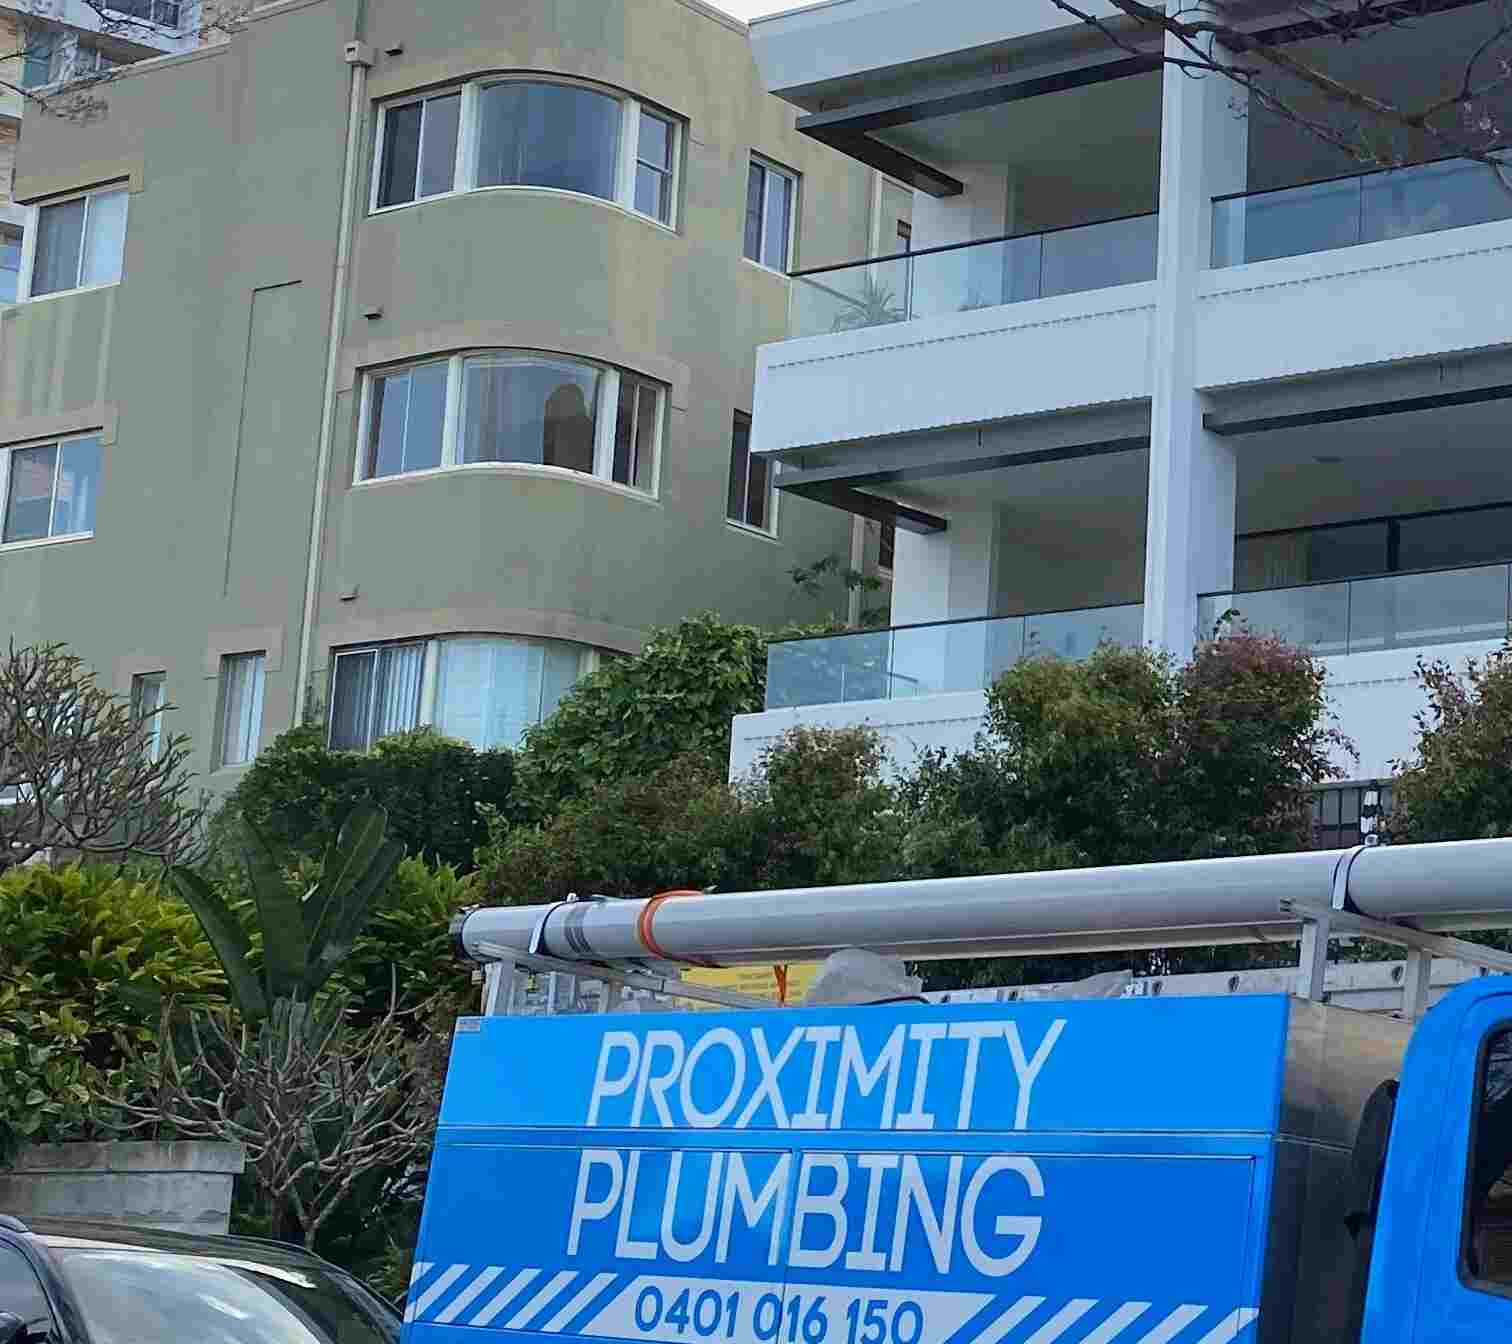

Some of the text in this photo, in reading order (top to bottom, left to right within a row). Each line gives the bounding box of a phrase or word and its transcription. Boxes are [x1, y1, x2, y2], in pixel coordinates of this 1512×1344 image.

[586, 1019, 1067, 1130] PROXIMITY
[567, 1149, 1046, 1277] PLUMBING
[635, 1286, 740, 1337] 0401
[753, 1292, 828, 1344] 016
